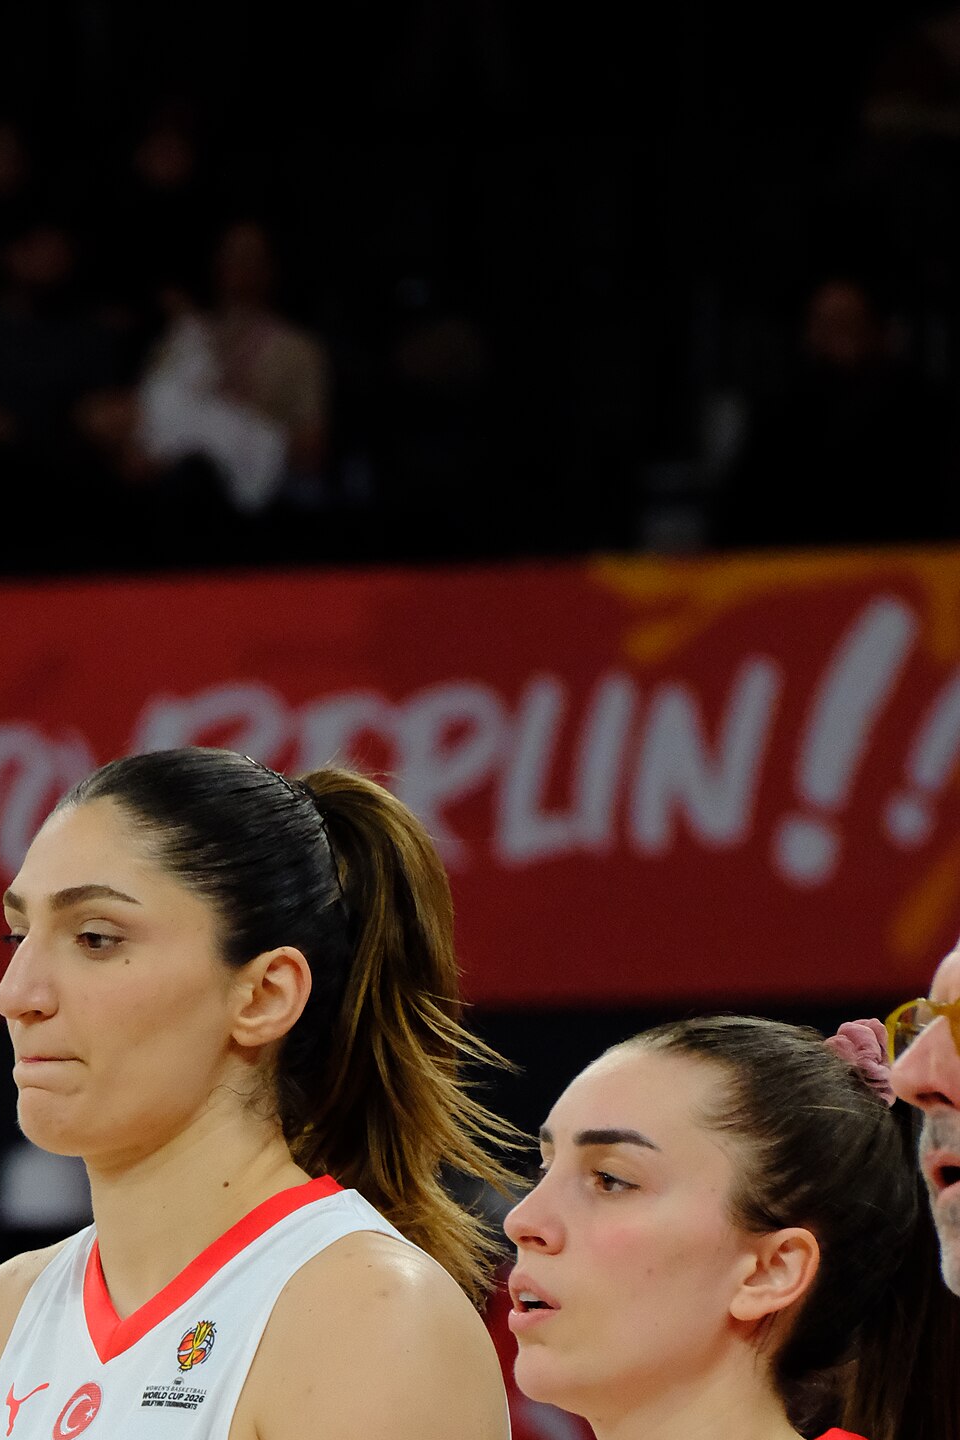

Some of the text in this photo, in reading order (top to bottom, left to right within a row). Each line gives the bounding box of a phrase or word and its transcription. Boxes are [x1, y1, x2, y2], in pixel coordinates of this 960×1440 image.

[171, 1386, 207, 1395] BASKETBALL
[142, 1391, 205, 1403] WORLD CUP 2026
